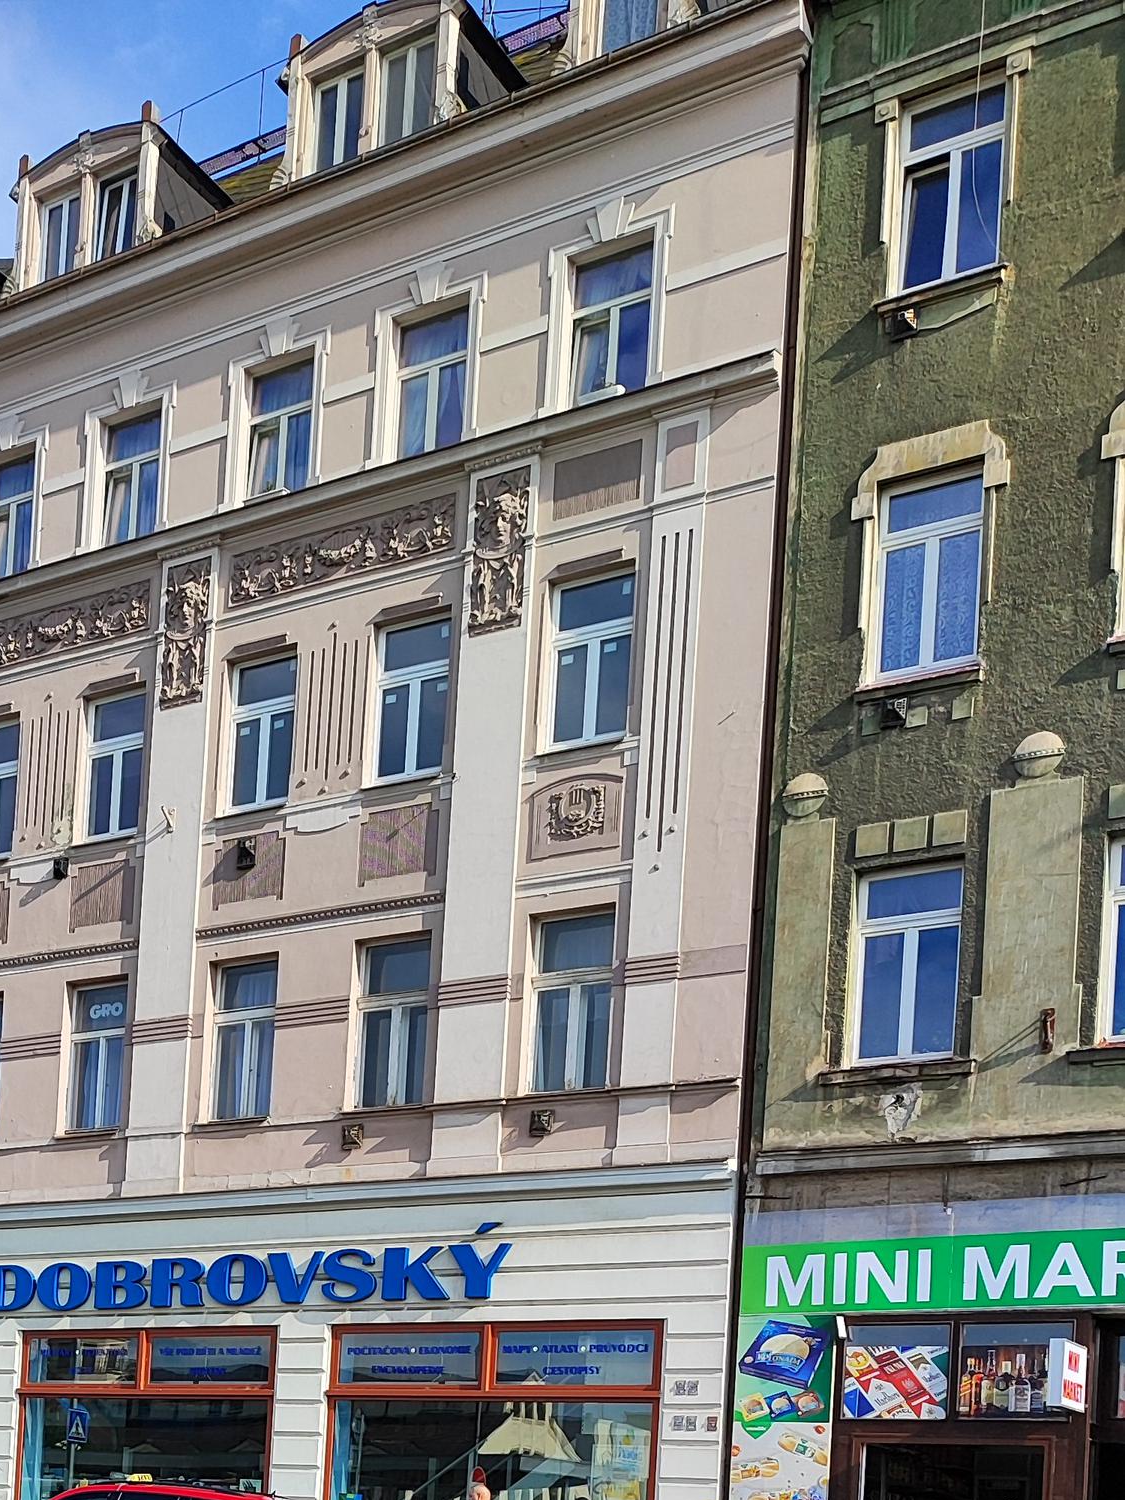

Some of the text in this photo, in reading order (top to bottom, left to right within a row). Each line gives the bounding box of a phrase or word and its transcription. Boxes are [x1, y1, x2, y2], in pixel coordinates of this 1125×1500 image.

[89, 1002, 123, 1019] GRO
[765, 1249, 932, 1307] MINI
[1068, 1350, 1081, 1374] MINI
[1063, 1378, 1083, 1404] MARKET
